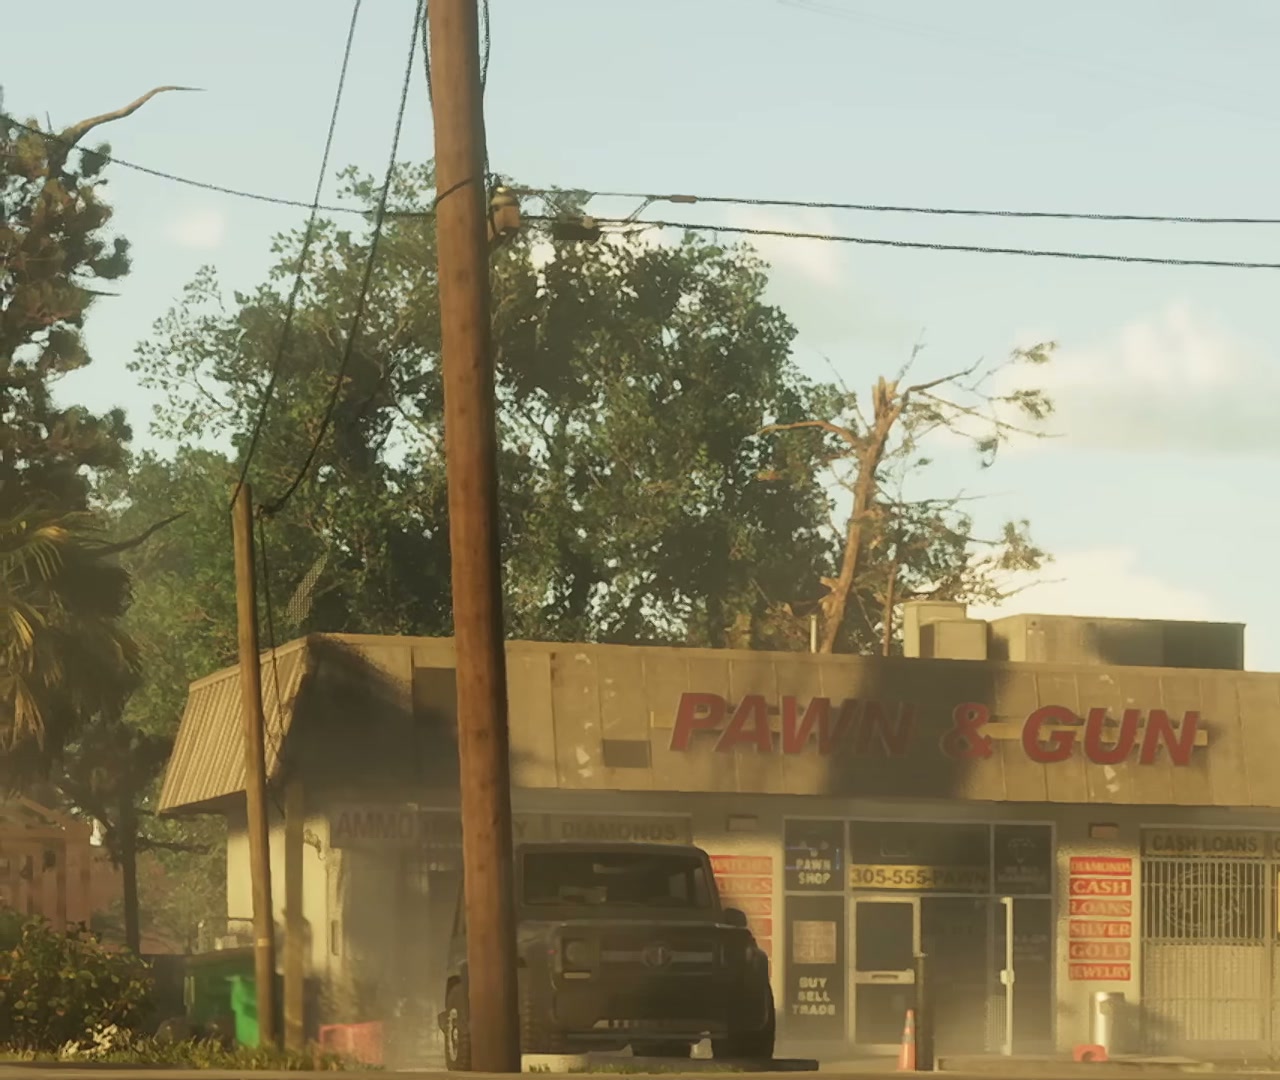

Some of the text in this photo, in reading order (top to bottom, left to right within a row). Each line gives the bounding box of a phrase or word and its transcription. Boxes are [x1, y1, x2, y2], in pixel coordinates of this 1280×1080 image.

[669, 691, 1202, 767] PAWN & GUN
[336, 810, 413, 838] AMMO
[560, 820, 678, 842] DIAMONDS
[1152, 835, 1258, 852] CASH LOANS
[795, 857, 832, 871] PAWN
[798, 871, 832, 885] SHOP
[1072, 880, 1128, 894] CASH
[1071, 901, 1131, 915] LOANS
[1071, 922, 1130, 937] SILVER
[1071, 943, 1130, 958] GOLD
[799, 976, 828, 989] BUY
[798, 989, 831, 1002] SELL
[792, 1003, 836, 1016] TRADE
